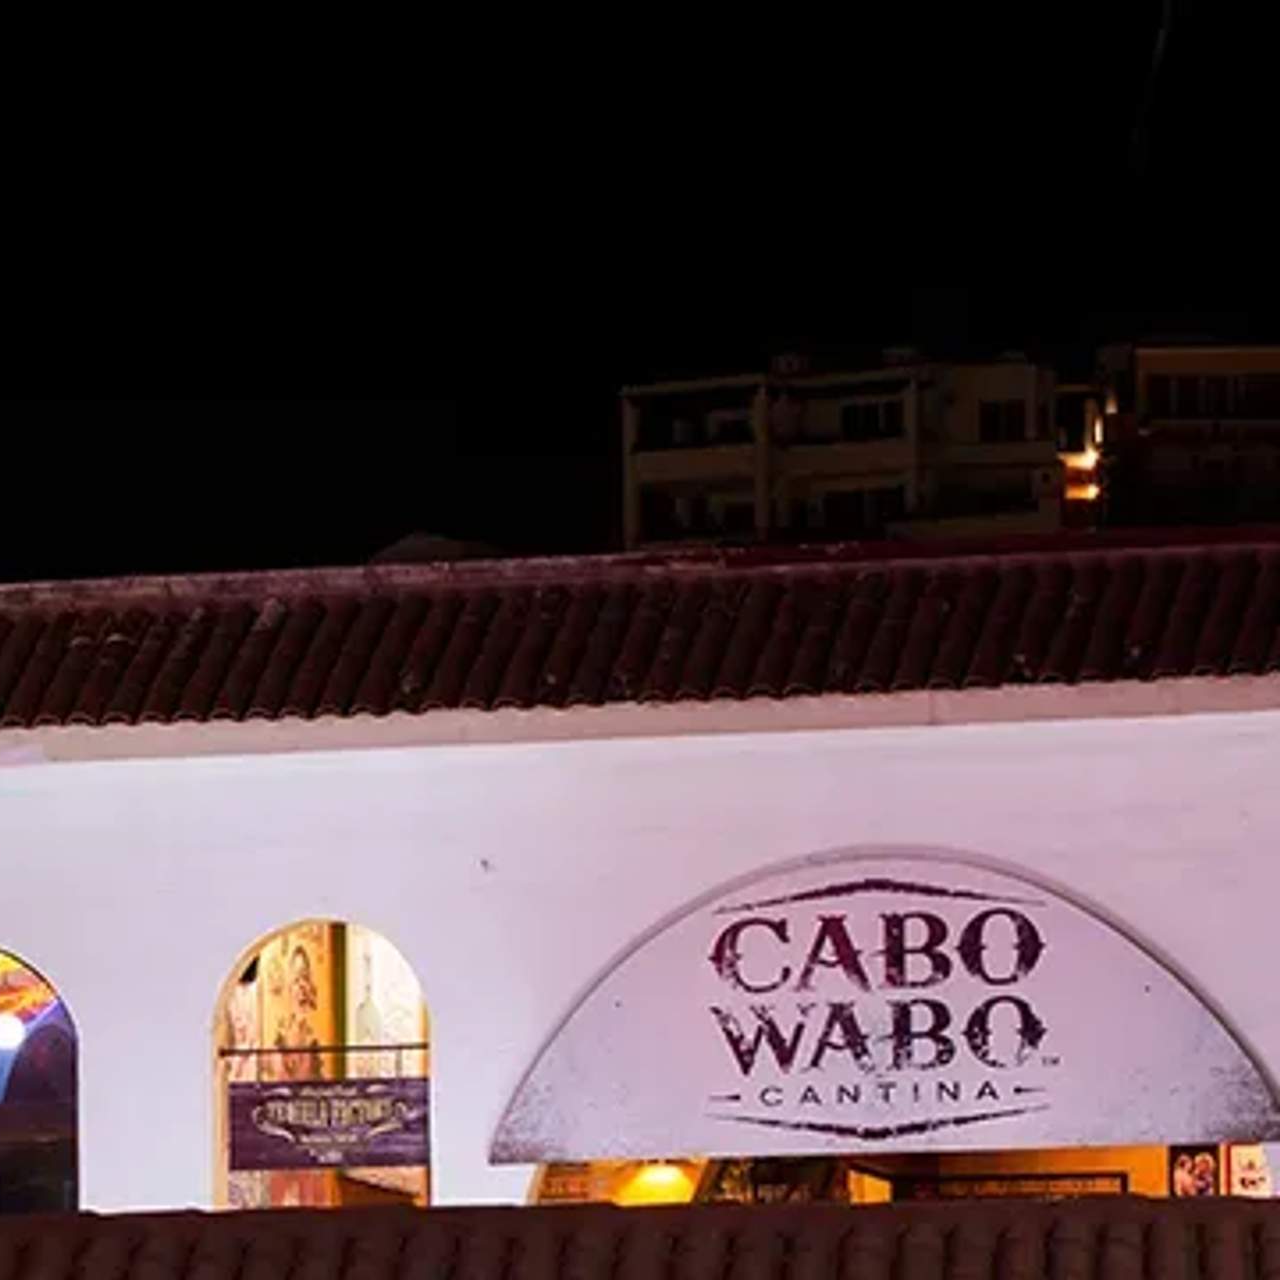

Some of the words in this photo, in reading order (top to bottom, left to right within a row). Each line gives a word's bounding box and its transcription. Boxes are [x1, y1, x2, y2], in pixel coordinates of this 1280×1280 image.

[708, 906, 1047, 996] CABO
[709, 995, 1048, 1077] WABO
[758, 1080, 1001, 1108] CANTINA
